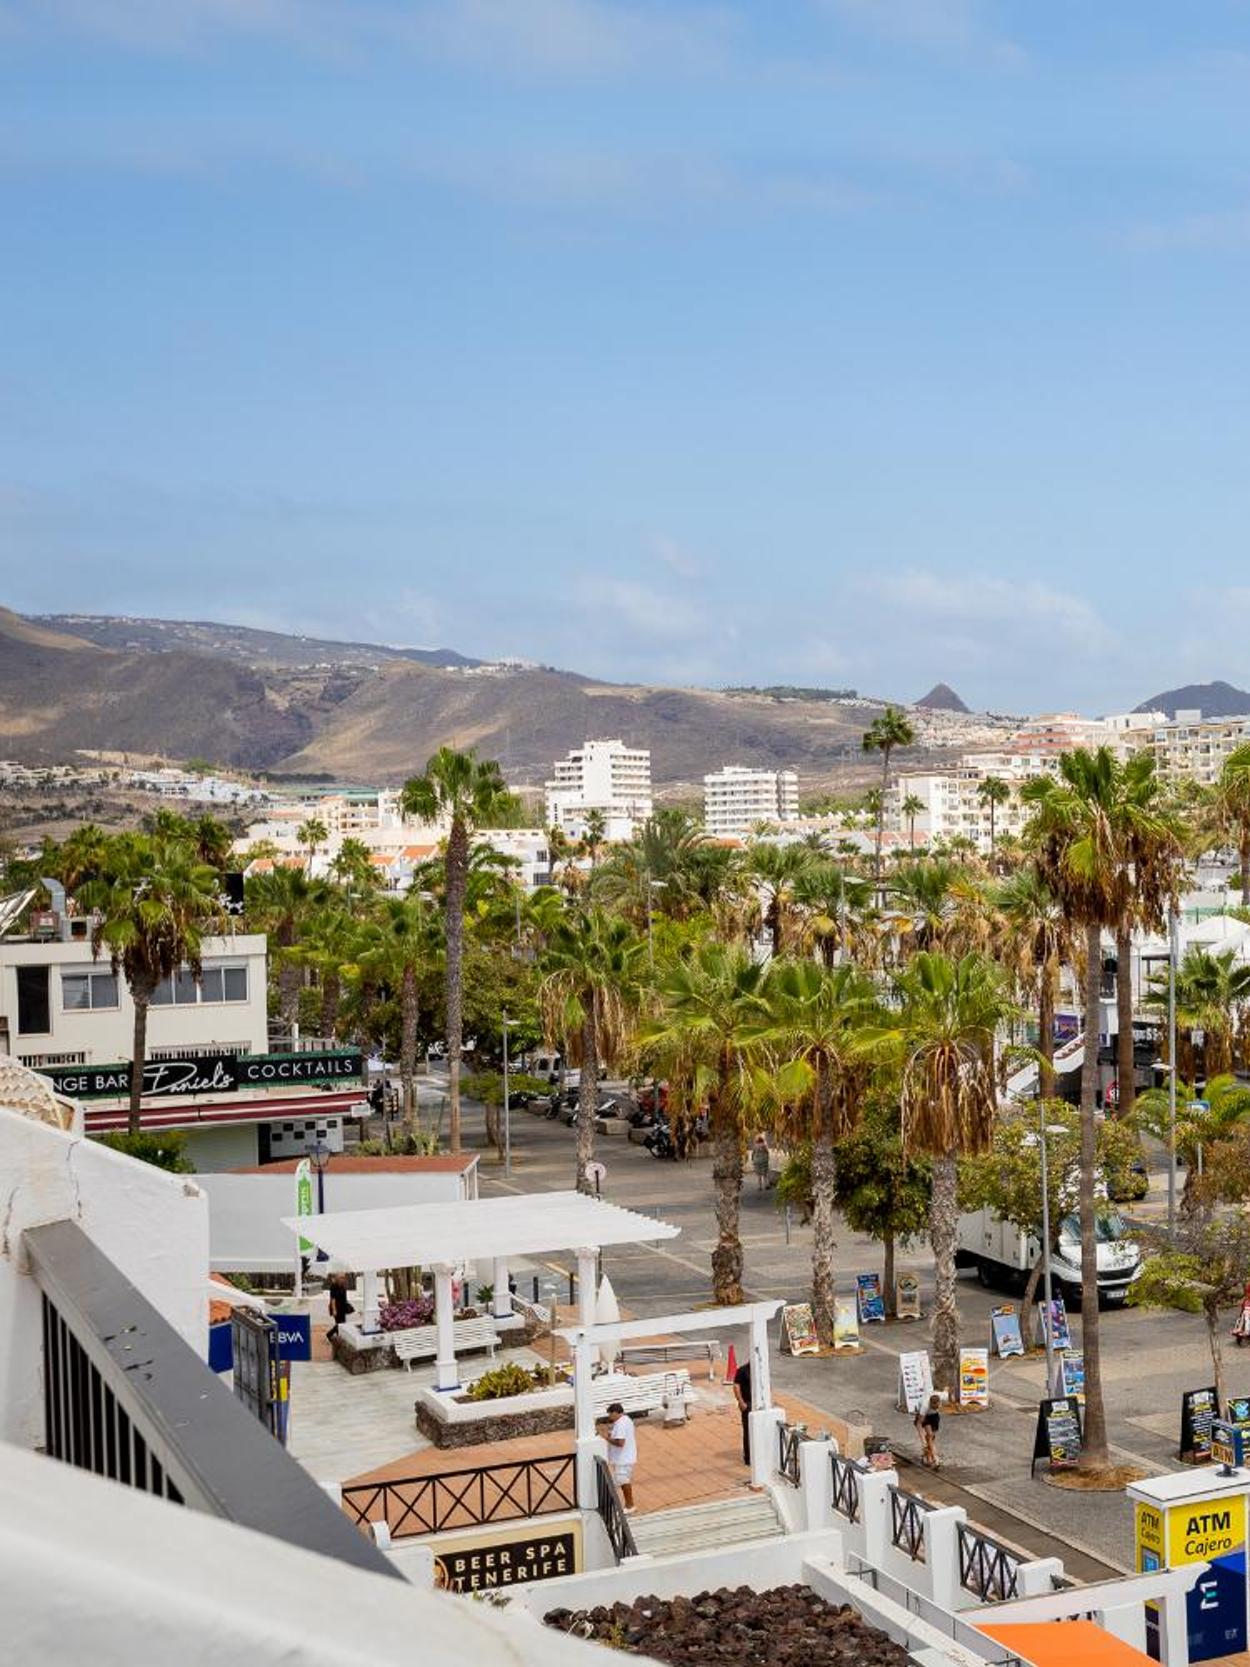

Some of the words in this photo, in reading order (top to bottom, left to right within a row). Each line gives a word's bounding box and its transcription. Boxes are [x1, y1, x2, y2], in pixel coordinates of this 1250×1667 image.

[95, 1073, 129, 1090] BAR
[142, 1060, 234, 1095] Daniel's
[247, 1058, 353, 1080] COCKTAILS
[1186, 1511, 1231, 1536] ATM
[455, 1551, 511, 1573] BEER
[526, 1541, 566, 1560] SPA
[1184, 1537, 1232, 1556] Cajero
[454, 1559, 566, 1594] TENERIFE
